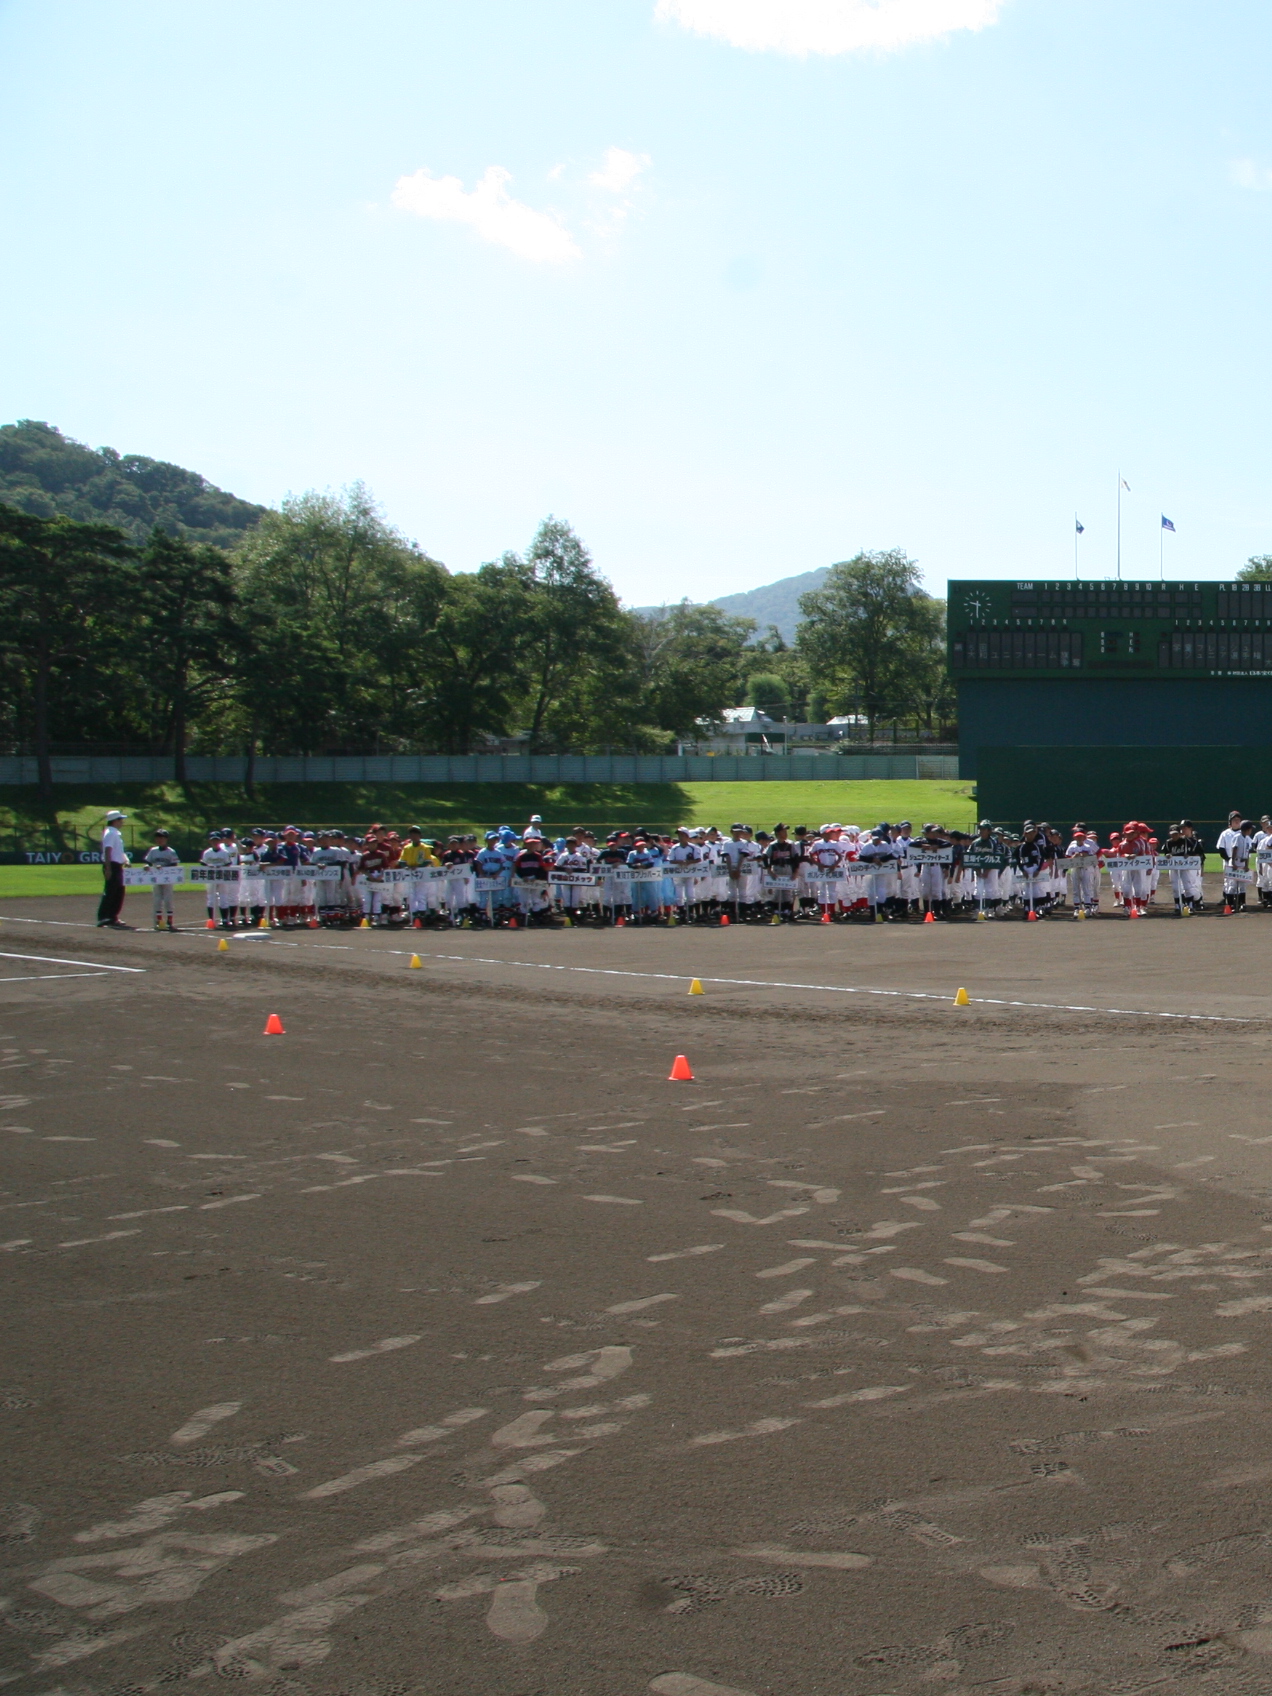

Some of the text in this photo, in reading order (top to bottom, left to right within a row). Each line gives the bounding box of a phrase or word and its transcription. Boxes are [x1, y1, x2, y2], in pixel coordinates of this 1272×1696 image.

[1017, 583, 1199, 591] TEAM 1 2 3 4 5 6 7 8 9 10 R H E
[1219, 583, 1226, 592] PL
[1242, 583, 1250, 592] 2B
[1253, 583, 1260, 592] 3B
[80, 851, 133, 863] GRP
